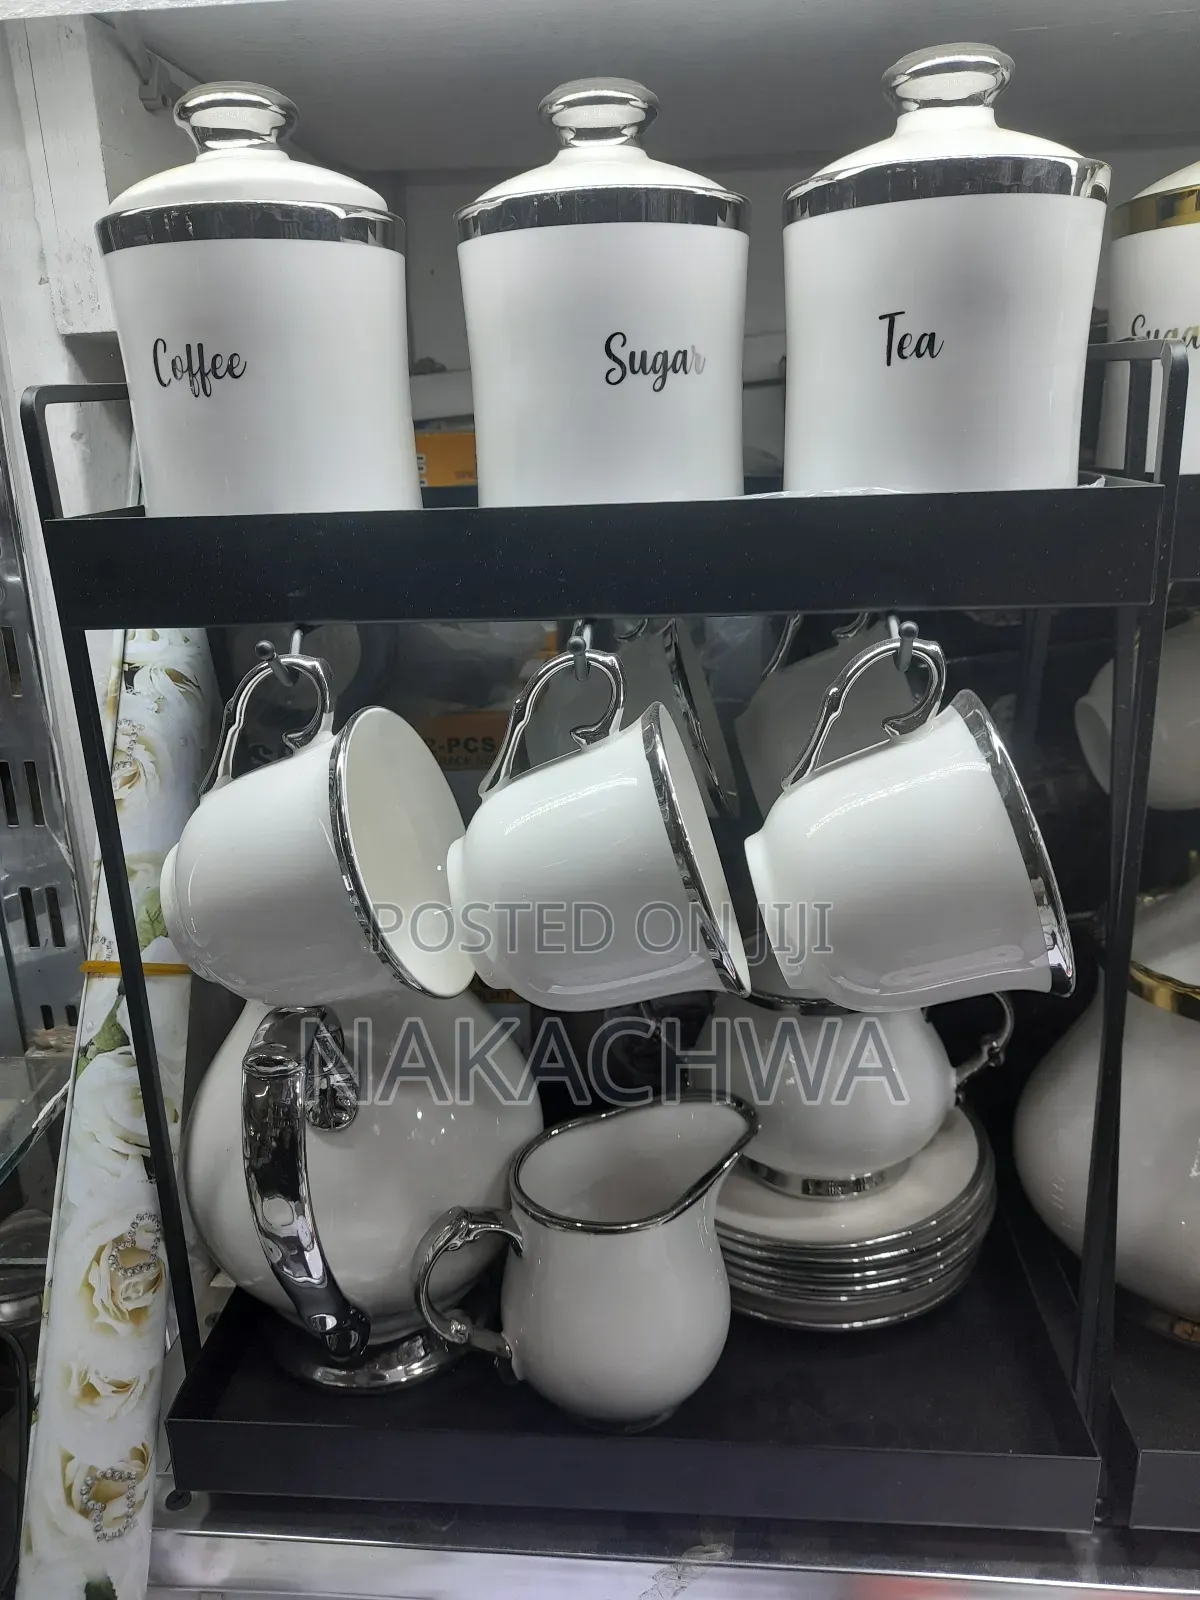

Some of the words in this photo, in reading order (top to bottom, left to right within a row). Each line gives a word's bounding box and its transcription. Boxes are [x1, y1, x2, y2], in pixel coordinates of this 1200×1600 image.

[153, 338, 247, 398] Coffee
[605, 331, 706, 392] Sugar
[878, 311, 945, 367] Tea
